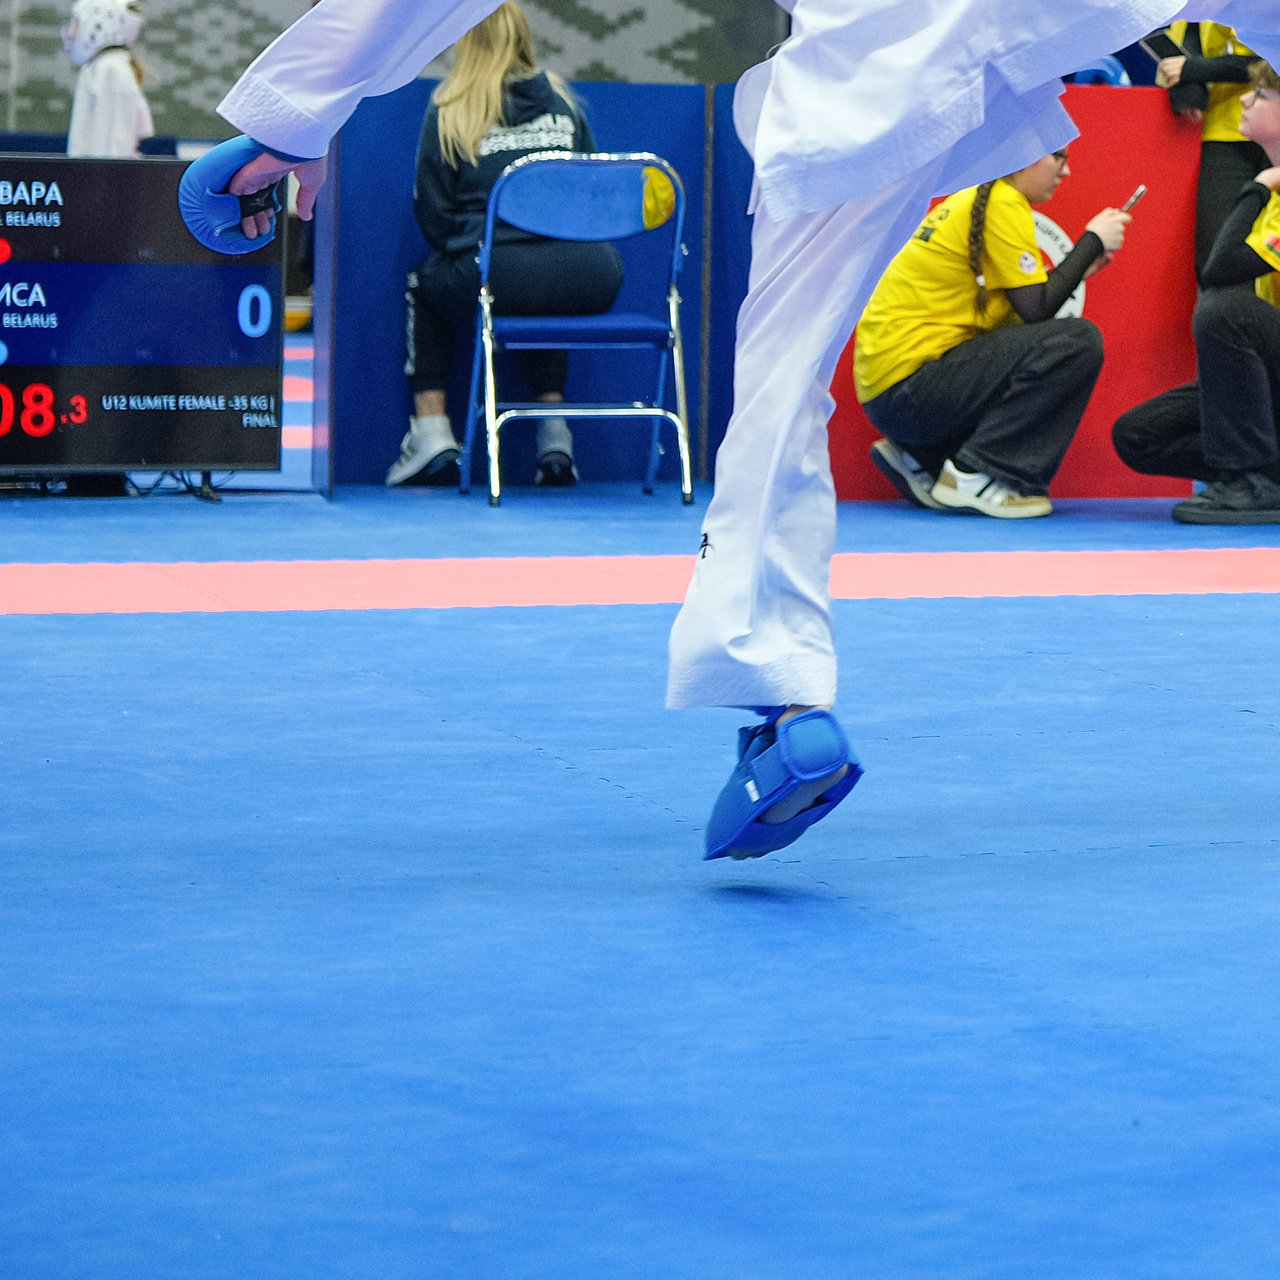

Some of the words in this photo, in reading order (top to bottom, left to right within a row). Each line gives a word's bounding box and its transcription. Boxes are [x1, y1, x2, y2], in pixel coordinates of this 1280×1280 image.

[6, 211, 61, 227] BELARUS
[238, 284, 272, 338] 0
[3, 313, 58, 328] BELARUS
[102, 395, 127, 410] U12
[129, 395, 176, 410] KUMITE
[178, 395, 226, 410] FEMALE
[227, 395, 248, 410] -35
[250, 395, 268, 410] KG
[242, 413, 278, 428] FINAL
